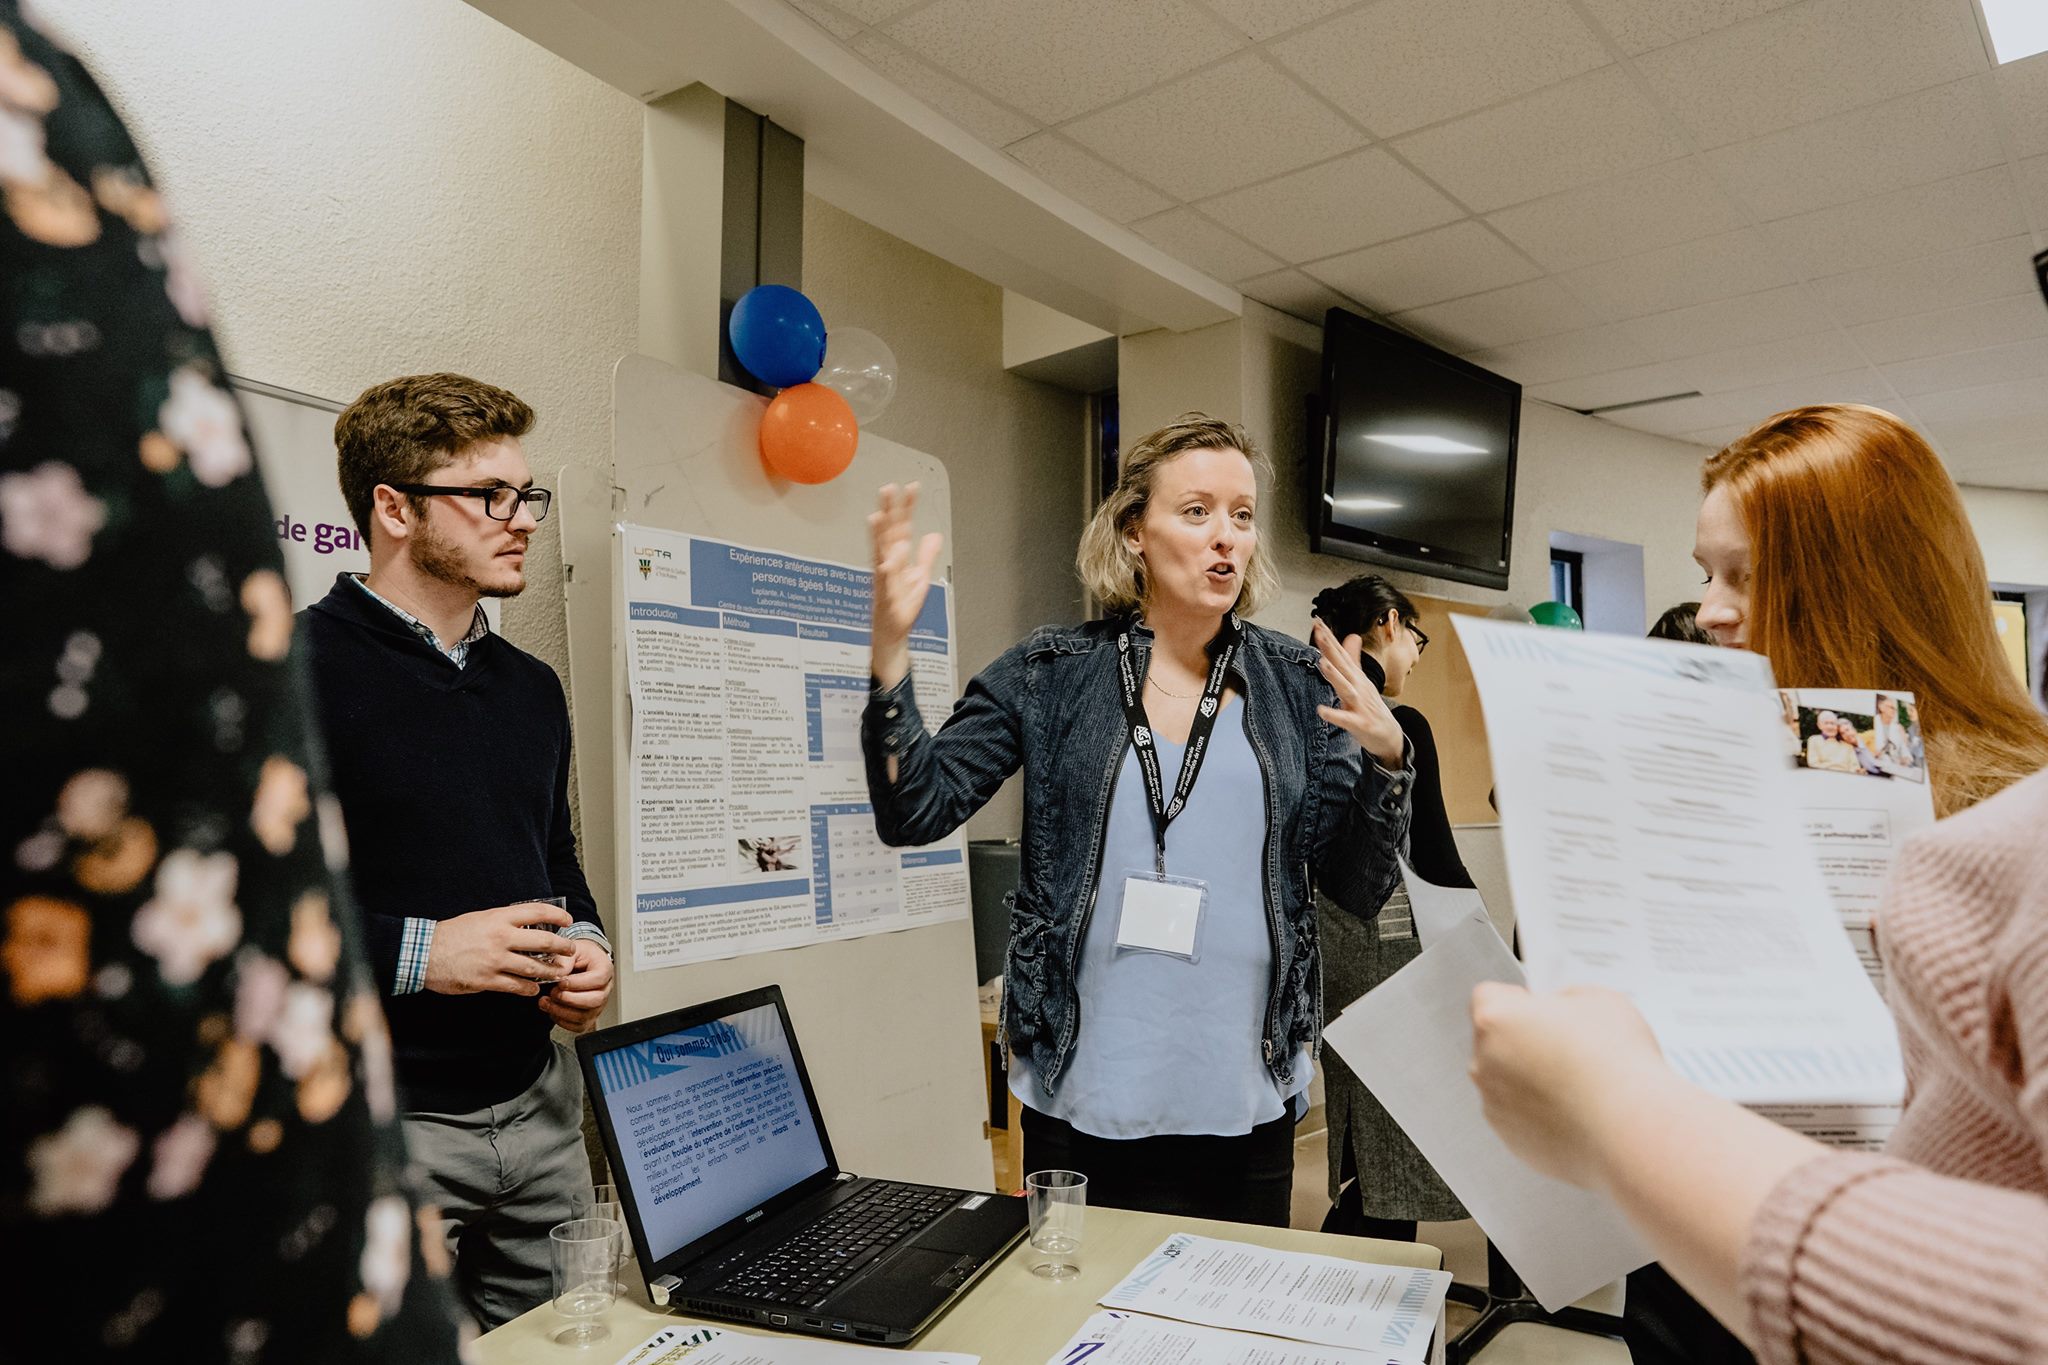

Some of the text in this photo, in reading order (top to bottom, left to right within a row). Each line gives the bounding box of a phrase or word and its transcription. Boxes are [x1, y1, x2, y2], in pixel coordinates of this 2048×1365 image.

[274, 514, 361, 554] de gar
[729, 549, 874, 586] Expériences antérieures avec la mor
[752, 571, 875, 600] personnes âgées face au suici
[631, 606, 678, 621] Introduction
[1200, 696, 1218, 718] AGE
[1133, 725, 1151, 747] AGE
[1194, 735, 1206, 753] l'UQTR
[1147, 749, 1158, 777] Association
[1177, 746, 1195, 793] Association générale
[1167, 796, 1184, 819] AGE
[638, 896, 687, 910] Hypothèses
[656, 1046, 674, 1063] Qui
[675, 1030, 731, 1058] sommes-nous
[626, 1103, 643, 1114] Nous
[646, 1093, 671, 1107] sommes
[674, 1089, 683, 1098] un
[684, 1072, 723, 1095] regroupement
[736, 1059, 764, 1075] chercheurs
[630, 1063, 784, 1126] comme thématique de recherche l'intervention précoce
[633, 1071, 786, 1138] auprès des jeunes enfants présentant des difficultés
[679, 1132, 685, 1143] et
[688, 1119, 723, 1139] l'intervention
[726, 1110, 744, 1125] auprès
[745, 1106, 755, 1115] des
[775, 1088, 792, 1102] enfants
[699, 1108, 722, 1122] Plusieurs
[723, 1105, 732, 1113] de
[732, 1101, 742, 1110] nos
[643, 1156, 662, 1172] ayant
[662, 1152, 672, 1163] un
[671, 1143, 693, 1159] trouble
[693, 1139, 702, 1149] du
[703, 1131, 723, 1147] spectre
[723, 1127, 731, 1136] de
[646, 1166, 670, 1183] milieux
[718, 1129, 747, 1150] accueillent
[771, 1108, 798, 1126] considérant
[650, 1171, 684, 1197] également
[707, 1151, 728, 1168] enfants
[734, 1139, 750, 1155] ayant
[771, 1124, 789, 1137] retards
[793, 1117, 801, 1127] de
[653, 1175, 703, 1205] développement.
